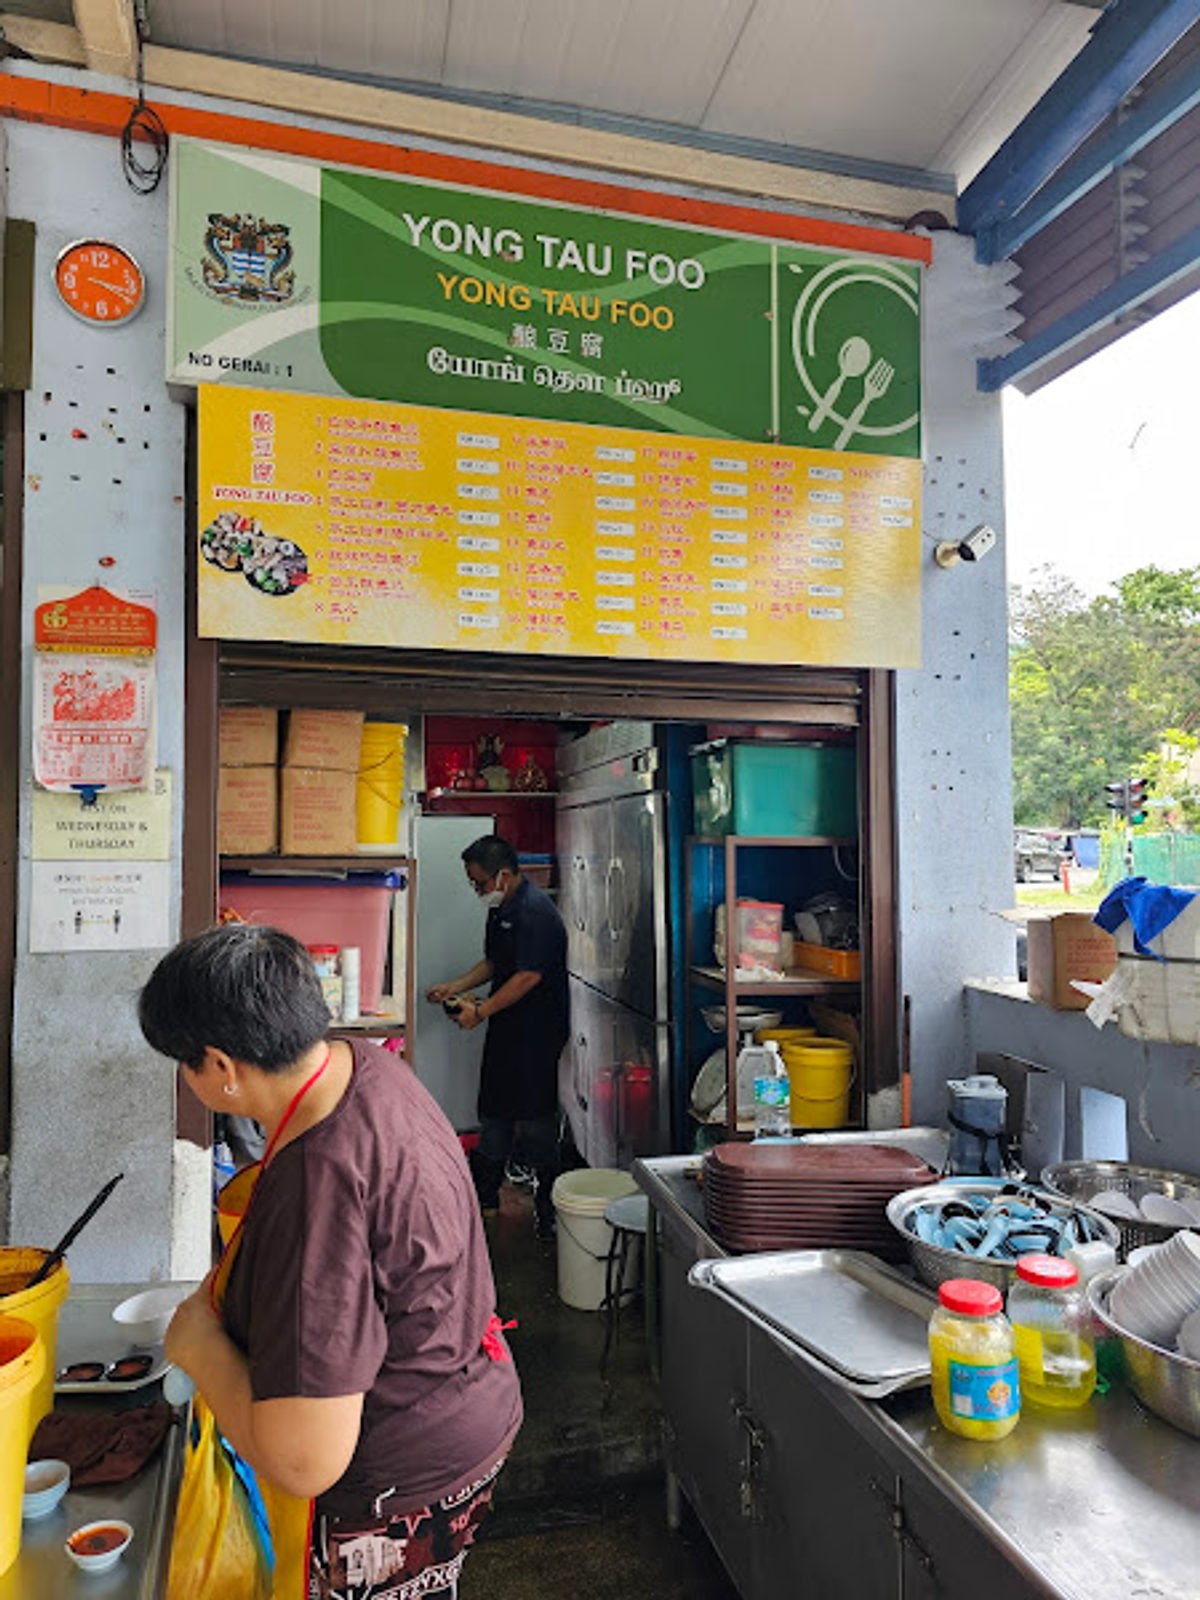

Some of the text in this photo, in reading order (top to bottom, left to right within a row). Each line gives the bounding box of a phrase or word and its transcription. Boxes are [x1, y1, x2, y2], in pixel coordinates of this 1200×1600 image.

[91, 251, 110, 268] 12
[402, 213, 705, 289] YONG TAU FOO
[437, 273, 674, 330] YONG TAU FOO
[189, 352, 212, 367] NO
[218, 356, 270, 375] GERAI
[285, 365, 293, 377] 1
[56, 821, 135, 831] WEDNESDAY
[68, 839, 136, 849] THURSDAY
